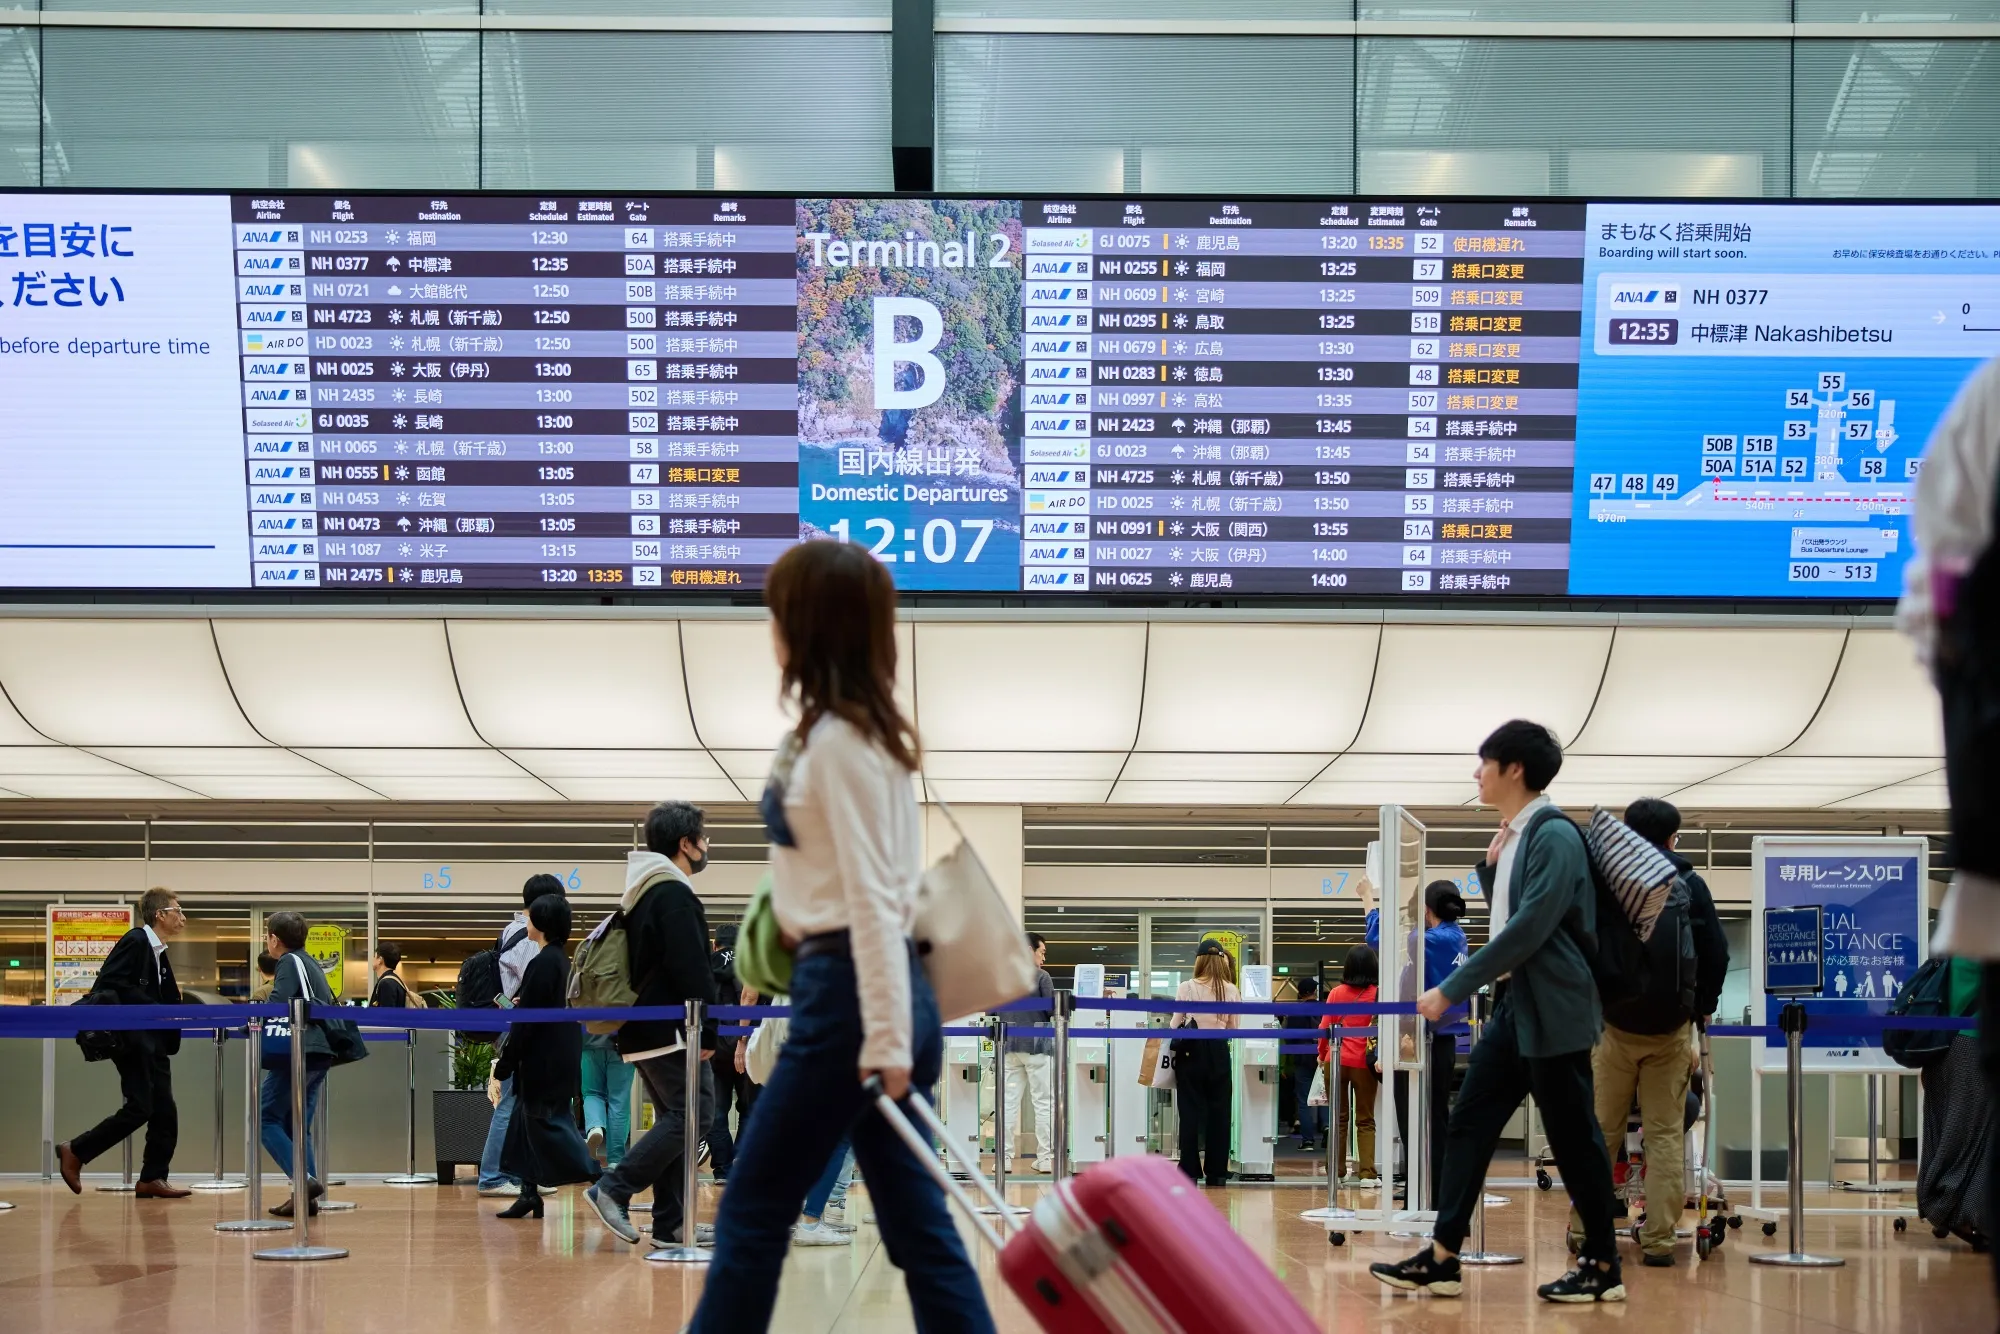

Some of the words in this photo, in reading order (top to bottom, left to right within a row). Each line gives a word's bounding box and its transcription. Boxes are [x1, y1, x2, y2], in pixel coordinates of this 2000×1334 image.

[431, 201, 448, 210] 行先
[540, 201, 556, 211] 定刻
[626, 202, 649, 211] ゲート
[721, 202, 738, 211] 備考
[1222, 205, 1239, 214] 行先
[1331, 206, 1348, 215] 定刻
[1417, 207, 1440, 216] ゲート
[1512, 207, 1528, 217] 備考
[257, 211, 281, 219] Airline
[333, 212, 354, 221] Flight
[419, 212, 461, 220] Destination
[578, 213, 614, 221] Estimated
[1123, 216, 1145, 226] Flight
[1368, 218, 1405, 226] Estimated
[311, 230, 331, 243] NH
[335, 231, 368, 243] 0253
[407, 231, 436, 245] 福岡
[532, 231, 567, 244] 12:30
[632, 233, 647, 244] 64
[1602, 223, 1751, 242] まもなく搭乗開始
[0, 222, 134, 258] を目安に
[805, 232, 975, 268] Terminal
[989, 234, 1011, 268] 2
[1600, 247, 1653, 260] Boarding
[1658, 247, 1679, 257] will
[1684, 249, 1711, 258] start
[1715, 249, 1746, 258] soon.
[244, 259, 270, 269] ANA
[312, 257, 332, 269] NH
[336, 257, 368, 270] 0377
[409, 257, 451, 272] 中標津
[532, 258, 568, 271] 12:35
[627, 260, 653, 271] 50A
[664, 258, 736, 273] 搭乗手続中
[1032, 263, 1057, 273] ANA
[1100, 261, 1120, 274] NH
[1124, 261, 1157, 274] 0255
[1196, 262, 1225, 277] 福岡
[1321, 263, 1356, 275] 13:25
[1421, 264, 1435, 275] 57
[1452, 264, 1524, 279] 搭乗口変更
[0, 270, 125, 307] ださい
[1615, 292, 1643, 302] ANA
[1694, 290, 1719, 304] NH
[1726, 290, 1768, 305] 0377
[1619, 323, 1669, 340] 12:35
[1692, 324, 1748, 343] 中標津
[1755, 325, 1892, 342] Nakashibetsu
[0, 337, 60, 354] before
[68, 338, 161, 358] departure
[168, 338, 210, 354] time
[873, 297, 946, 410] B
[250, 365, 275, 374] ANA
[317, 362, 337, 375] NH
[341, 363, 373, 375] 0025
[413, 362, 489, 378] 大阪（伊丹）
[535, 363, 571, 376] 13:00
[635, 365, 650, 376] 65
[666, 364, 737, 379] 搭乗手続中
[1823, 376, 1840, 389] 55
[1791, 393, 1808, 405] 54
[1853, 393, 1869, 406] 56
[1819, 409, 1846, 419] 520m
[319, 415, 332, 427] 6J
[336, 415, 369, 427] 0035
[415, 415, 443, 429] 長崎
[537, 416, 573, 428] 13:00
[633, 417, 655, 428] 502
[667, 416, 738, 431] 搭乗手続中
[1789, 424, 1805, 437] 53
[1850, 424, 1867, 437] 57
[1707, 438, 1732, 451] 50B
[1747, 439, 1772, 451] 51B
[838, 448, 981, 477] 国内線出発
[1706, 460, 1733, 472] 50A
[1746, 460, 1772, 473] 51A
[1786, 460, 1802, 473] 52
[1815, 456, 1843, 465] 380m
[1865, 461, 1882, 474] 58
[1594, 477, 1612, 489] 47
[1626, 478, 1643, 490] 48
[1657, 478, 1674, 490] 49
[812, 484, 898, 502] Domestic
[904, 485, 1008, 504] Departures
[1048, 500, 1065, 508] AIR
[1069, 497, 1085, 506] DO
[1098, 496, 1117, 508] HD
[1121, 497, 1153, 508] 0025
[1314, 498, 1349, 510] 13:50
[1412, 499, 1426, 510] 55
[1443, 498, 1513, 513] 搭乗手続中
[1746, 500, 1774, 510] 540m
[1856, 501, 1884, 511] 260m
[1598, 513, 1626, 523] 870m
[1794, 509, 1804, 518] 2F
[829, 518, 994, 563] 12:07
[261, 571, 286, 580] ANA
[327, 569, 347, 581] NH
[351, 569, 382, 581] 2475
[421, 569, 463, 583] 鹿児島
[542, 570, 577, 582] 13:20
[588, 570, 622, 582] 13:35
[640, 571, 654, 581] 52
[671, 570, 741, 584] 使用機遅れ
[1793, 566, 1819, 578] 500
[1845, 566, 1871, 578] 513
[424, 867, 451, 888] B5
[1780, 865, 1902, 881] 専用レーン入り口
[1322, 873, 1348, 894] B7
[1768, 923, 1799, 932] SPECIAL
[1823, 913, 1861, 929] CIAL
[1769, 931, 1816, 941] ASSISTANCE
[1824, 934, 1902, 950] STANCE
[1823, 956, 1904, 966] が必要なお客様
